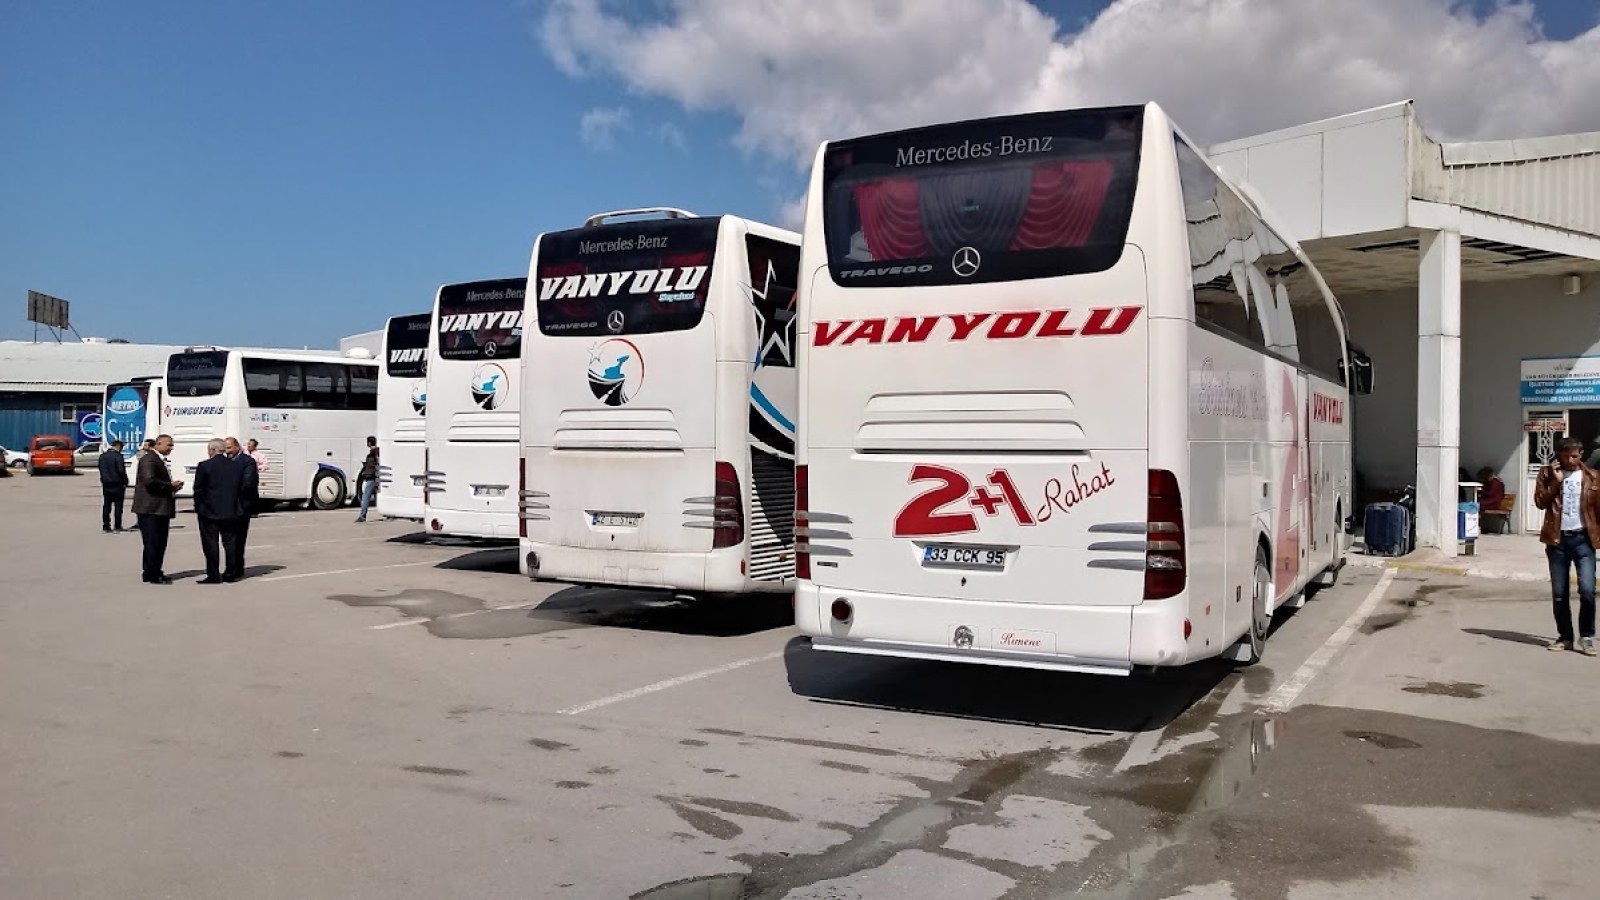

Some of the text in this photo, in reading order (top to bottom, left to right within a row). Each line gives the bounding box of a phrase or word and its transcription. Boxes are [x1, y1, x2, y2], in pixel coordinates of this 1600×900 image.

[895, 134, 1053, 168] Mercedes-Benz
[578, 235, 669, 255] Mercedes-Benz
[539, 265, 709, 301] VANYOLU
[840, 264, 933, 278] TRAVEGO
[544, 321, 598, 331] TRAVEGO
[811, 305, 1145, 348] VANYOLU
[111, 400, 140, 410] METRO
[107, 418, 143, 451] Suit
[892, 463, 1037, 538] 2+1
[930, 547, 1004, 564] 33 CCK 95
